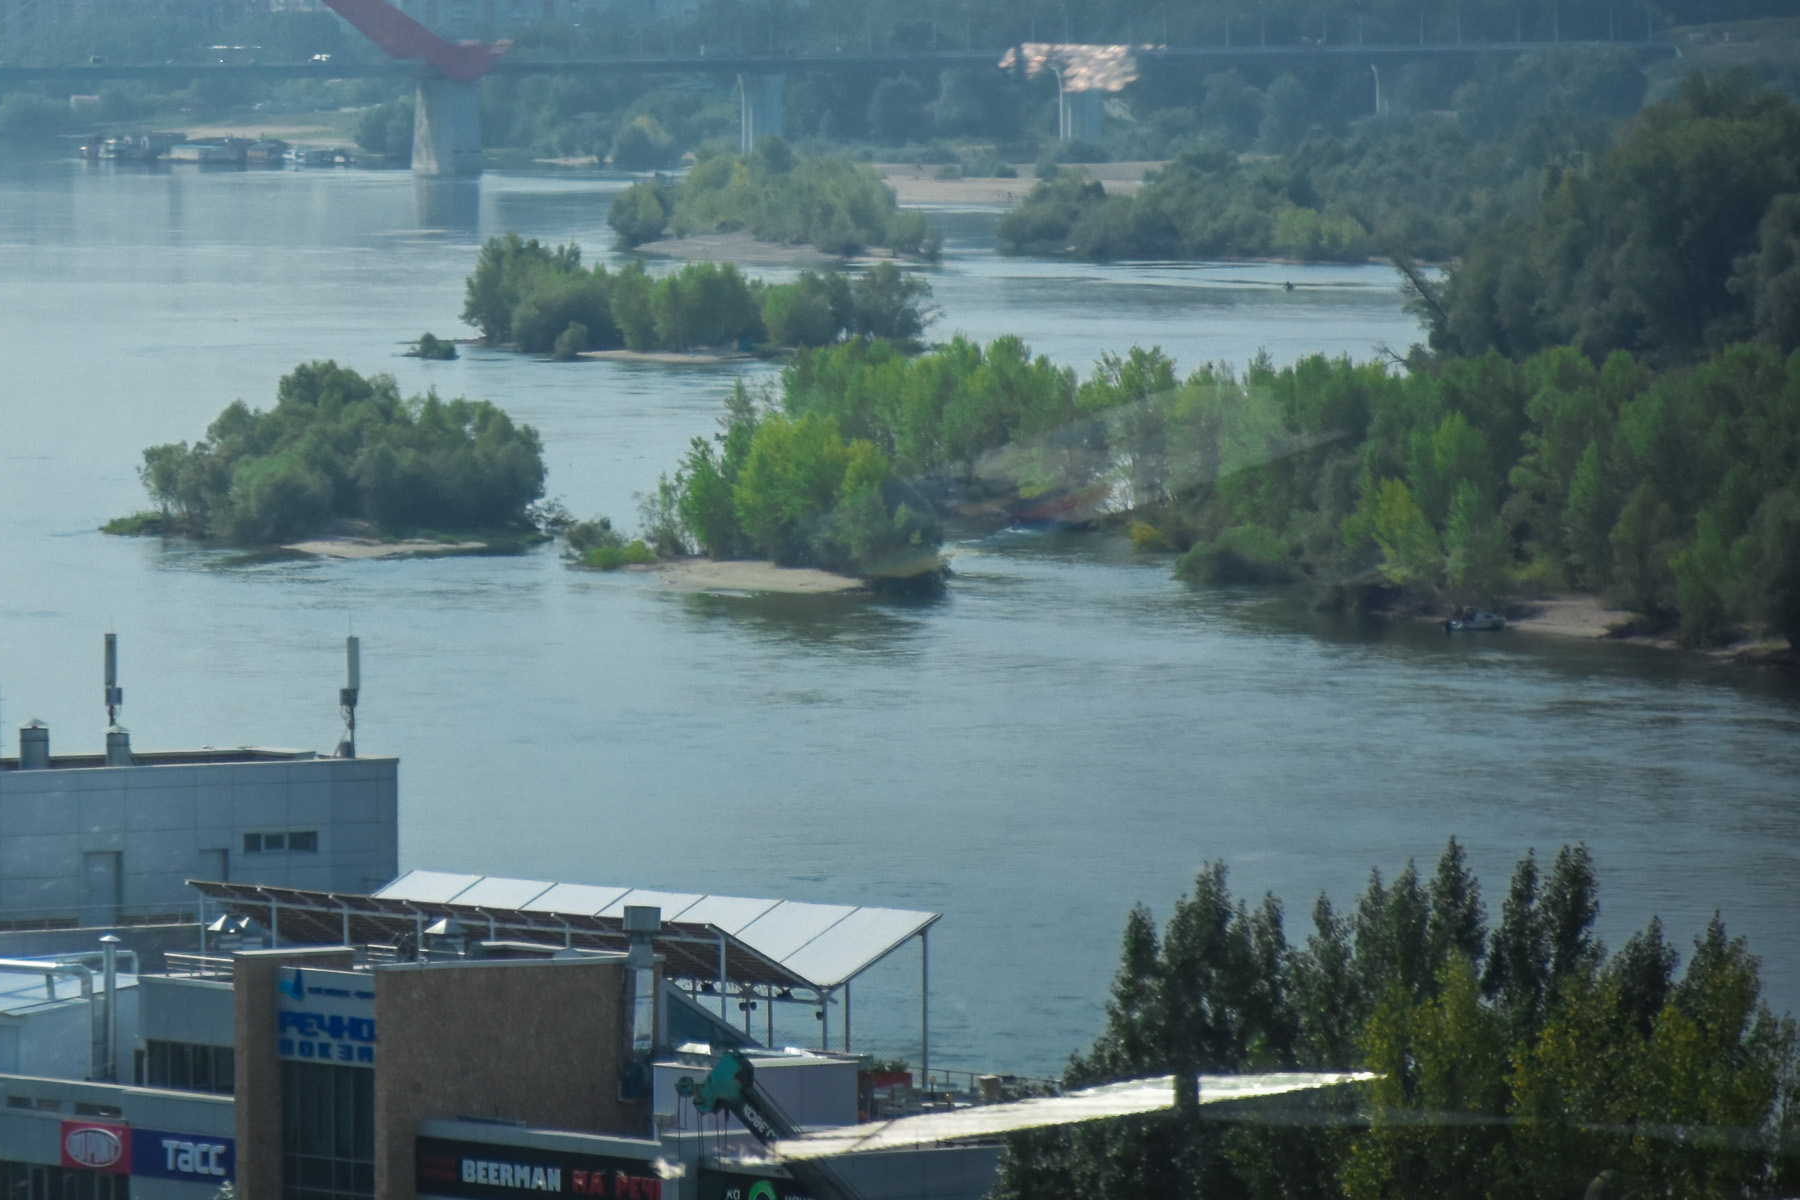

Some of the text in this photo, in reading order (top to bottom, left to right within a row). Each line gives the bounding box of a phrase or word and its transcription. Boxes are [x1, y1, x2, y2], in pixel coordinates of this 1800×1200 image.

[279, 1011, 374, 1042] РЕЧНО
[278, 1038, 374, 1063] ВОКЗА
[462, 1159, 561, 1193] BEERMAN
